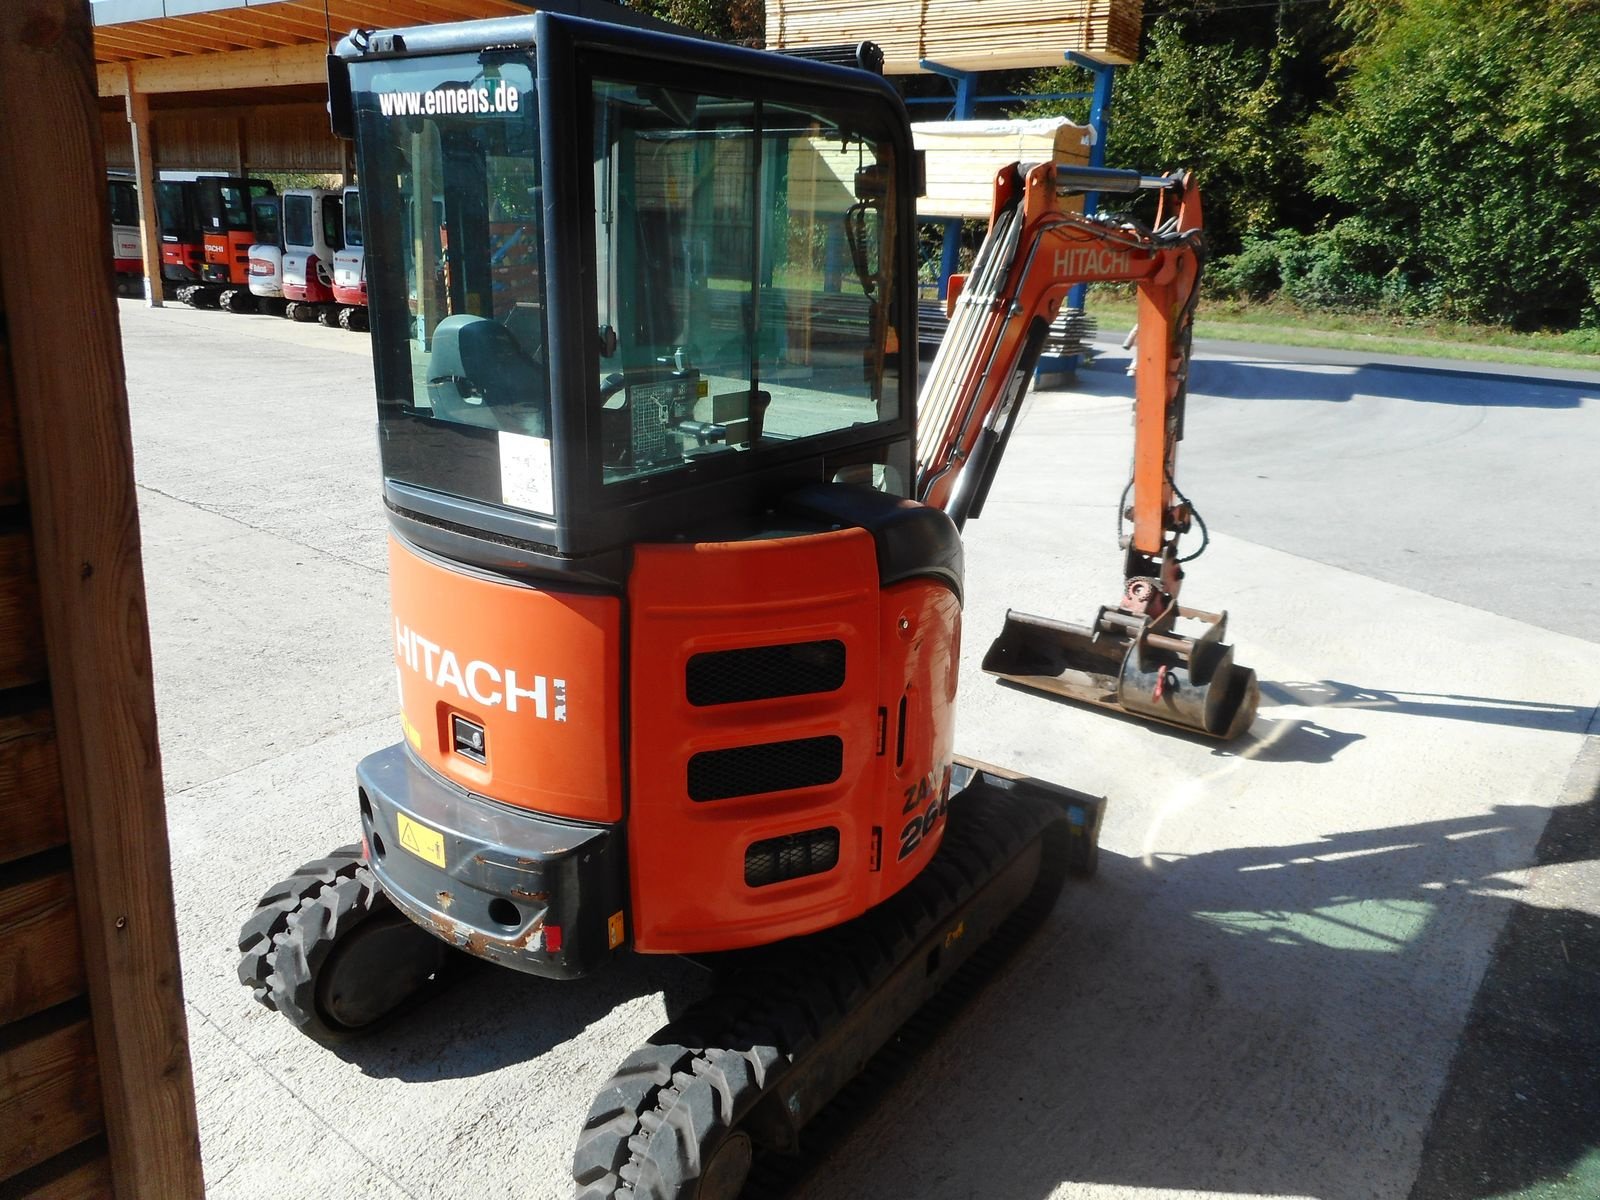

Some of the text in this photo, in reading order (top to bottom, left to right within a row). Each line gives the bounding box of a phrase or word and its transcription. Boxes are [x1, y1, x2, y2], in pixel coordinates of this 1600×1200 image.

[379, 80, 519, 116] www.ennens.de
[1053, 249, 1131, 277] HITACHI
[395, 616, 567, 722] HITACHI
